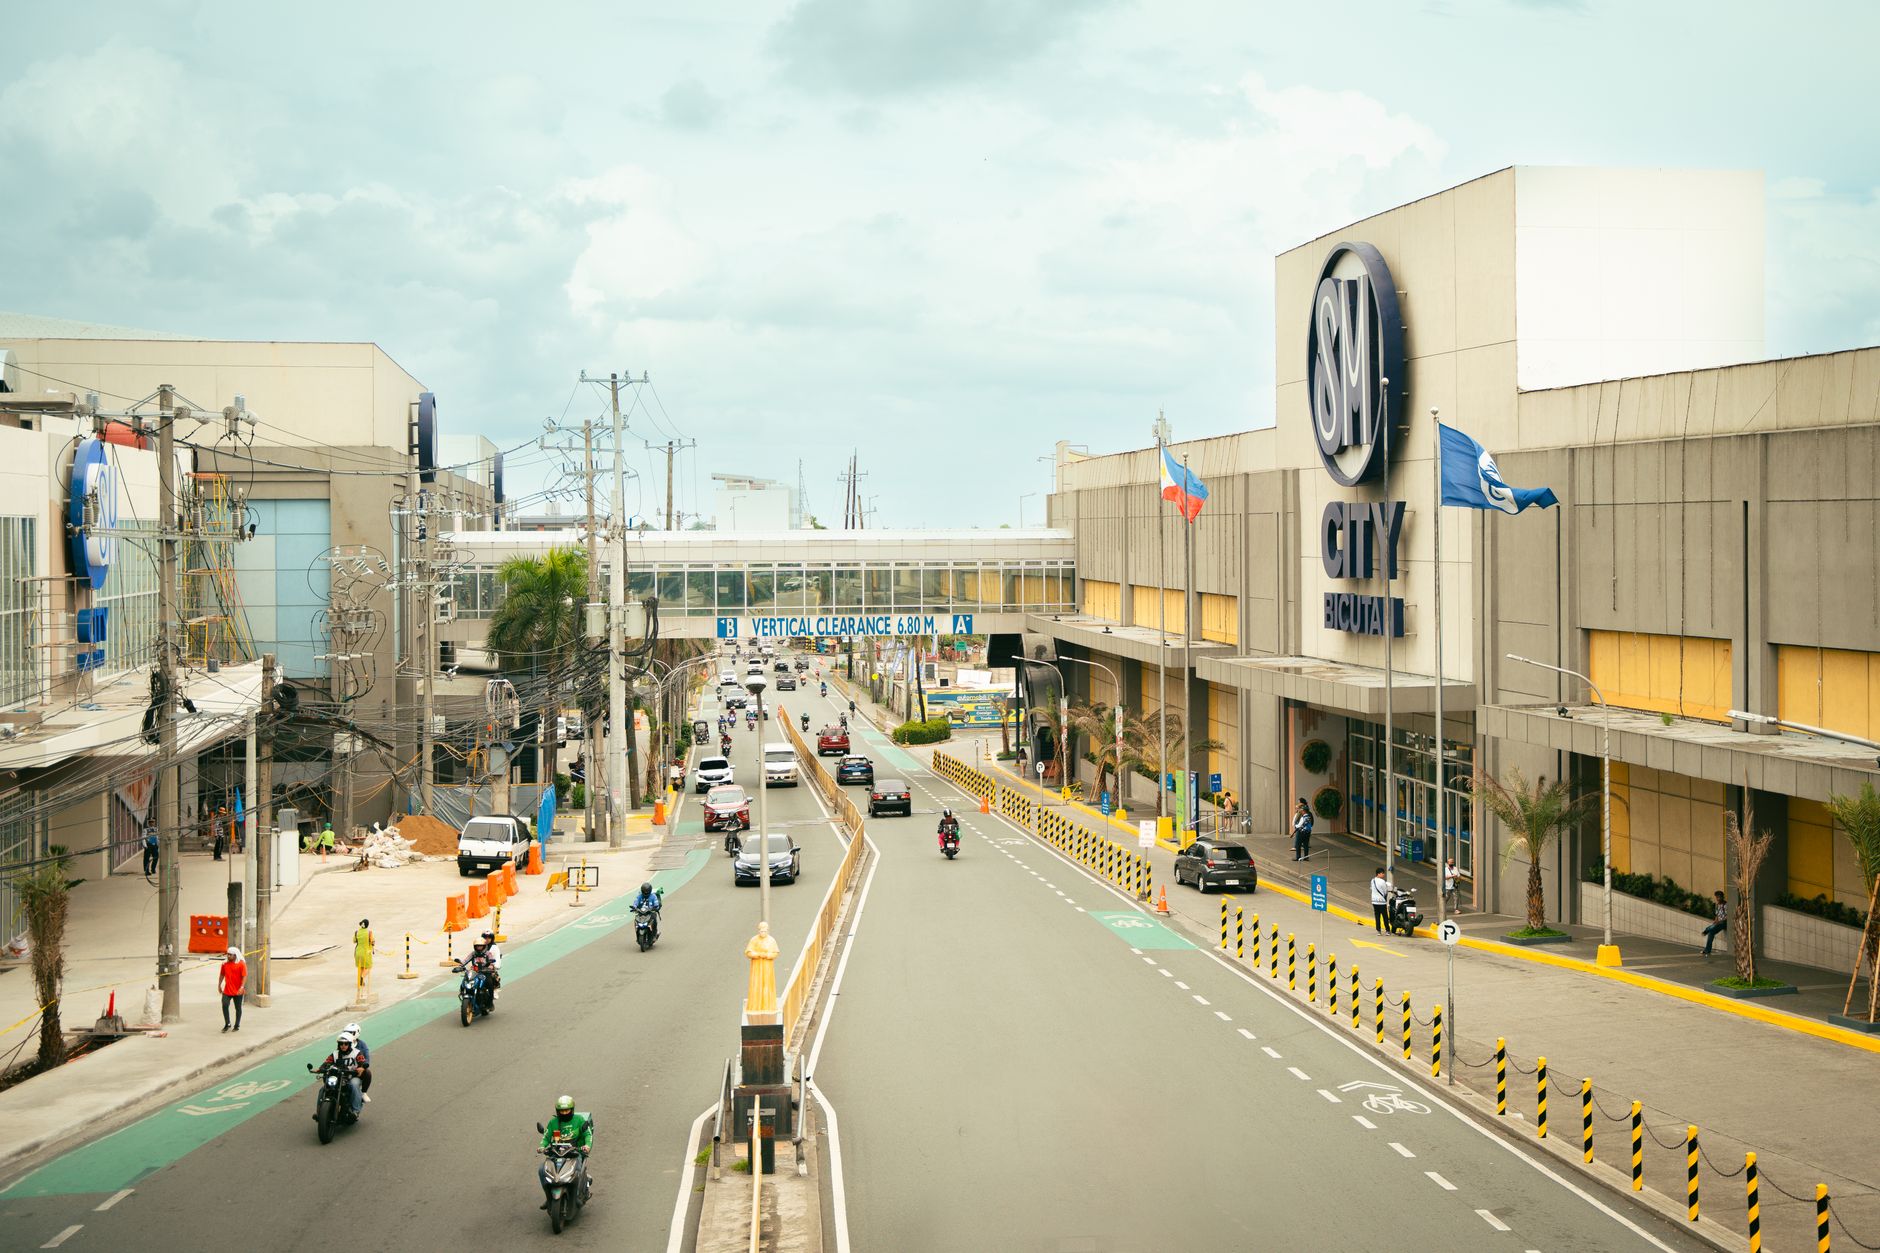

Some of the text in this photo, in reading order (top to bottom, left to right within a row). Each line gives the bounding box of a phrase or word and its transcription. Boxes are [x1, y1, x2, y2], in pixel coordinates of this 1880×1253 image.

[1314, 274, 1372, 455] SM
[1321, 501, 1405, 579] CITY
[726, 618, 735, 637] B
[752, 616, 938, 636] VERTICAL CLEARANCE 6.80 M.
[955, 616, 967, 634] A
[1444, 925, 1456, 941] P
